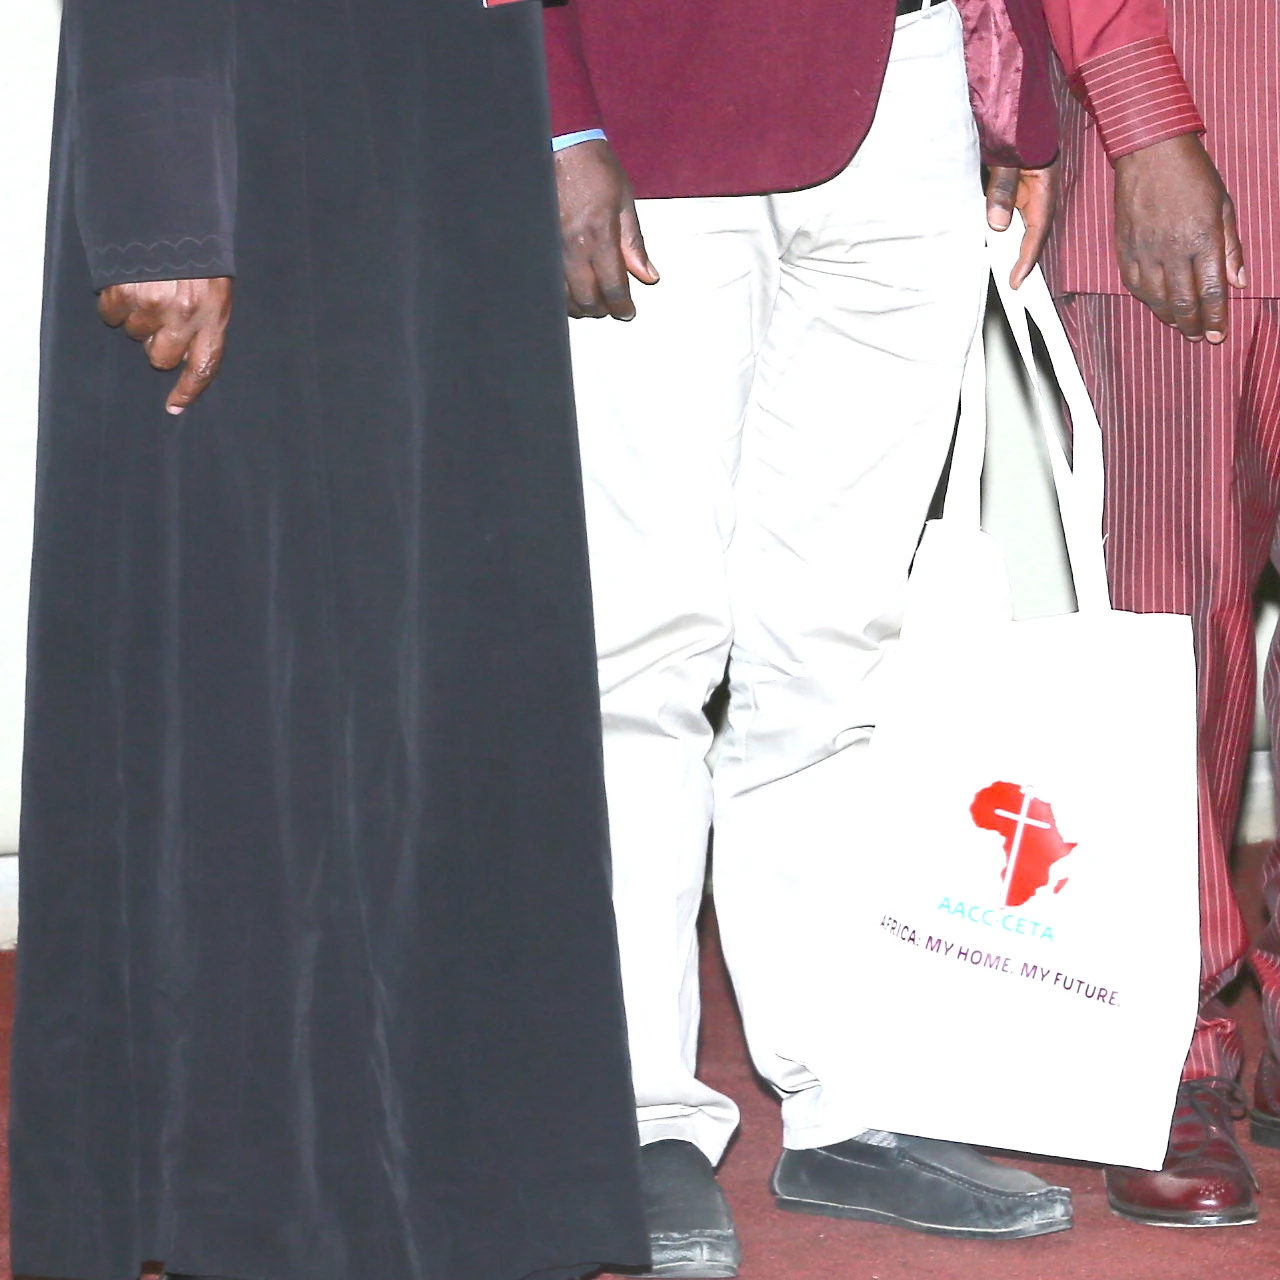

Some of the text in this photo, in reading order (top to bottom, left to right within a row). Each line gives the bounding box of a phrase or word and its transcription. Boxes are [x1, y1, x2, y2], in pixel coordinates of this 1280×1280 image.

[880, 915, 1120, 1007] AFRICA: MY HOME. MY FUTURE.
